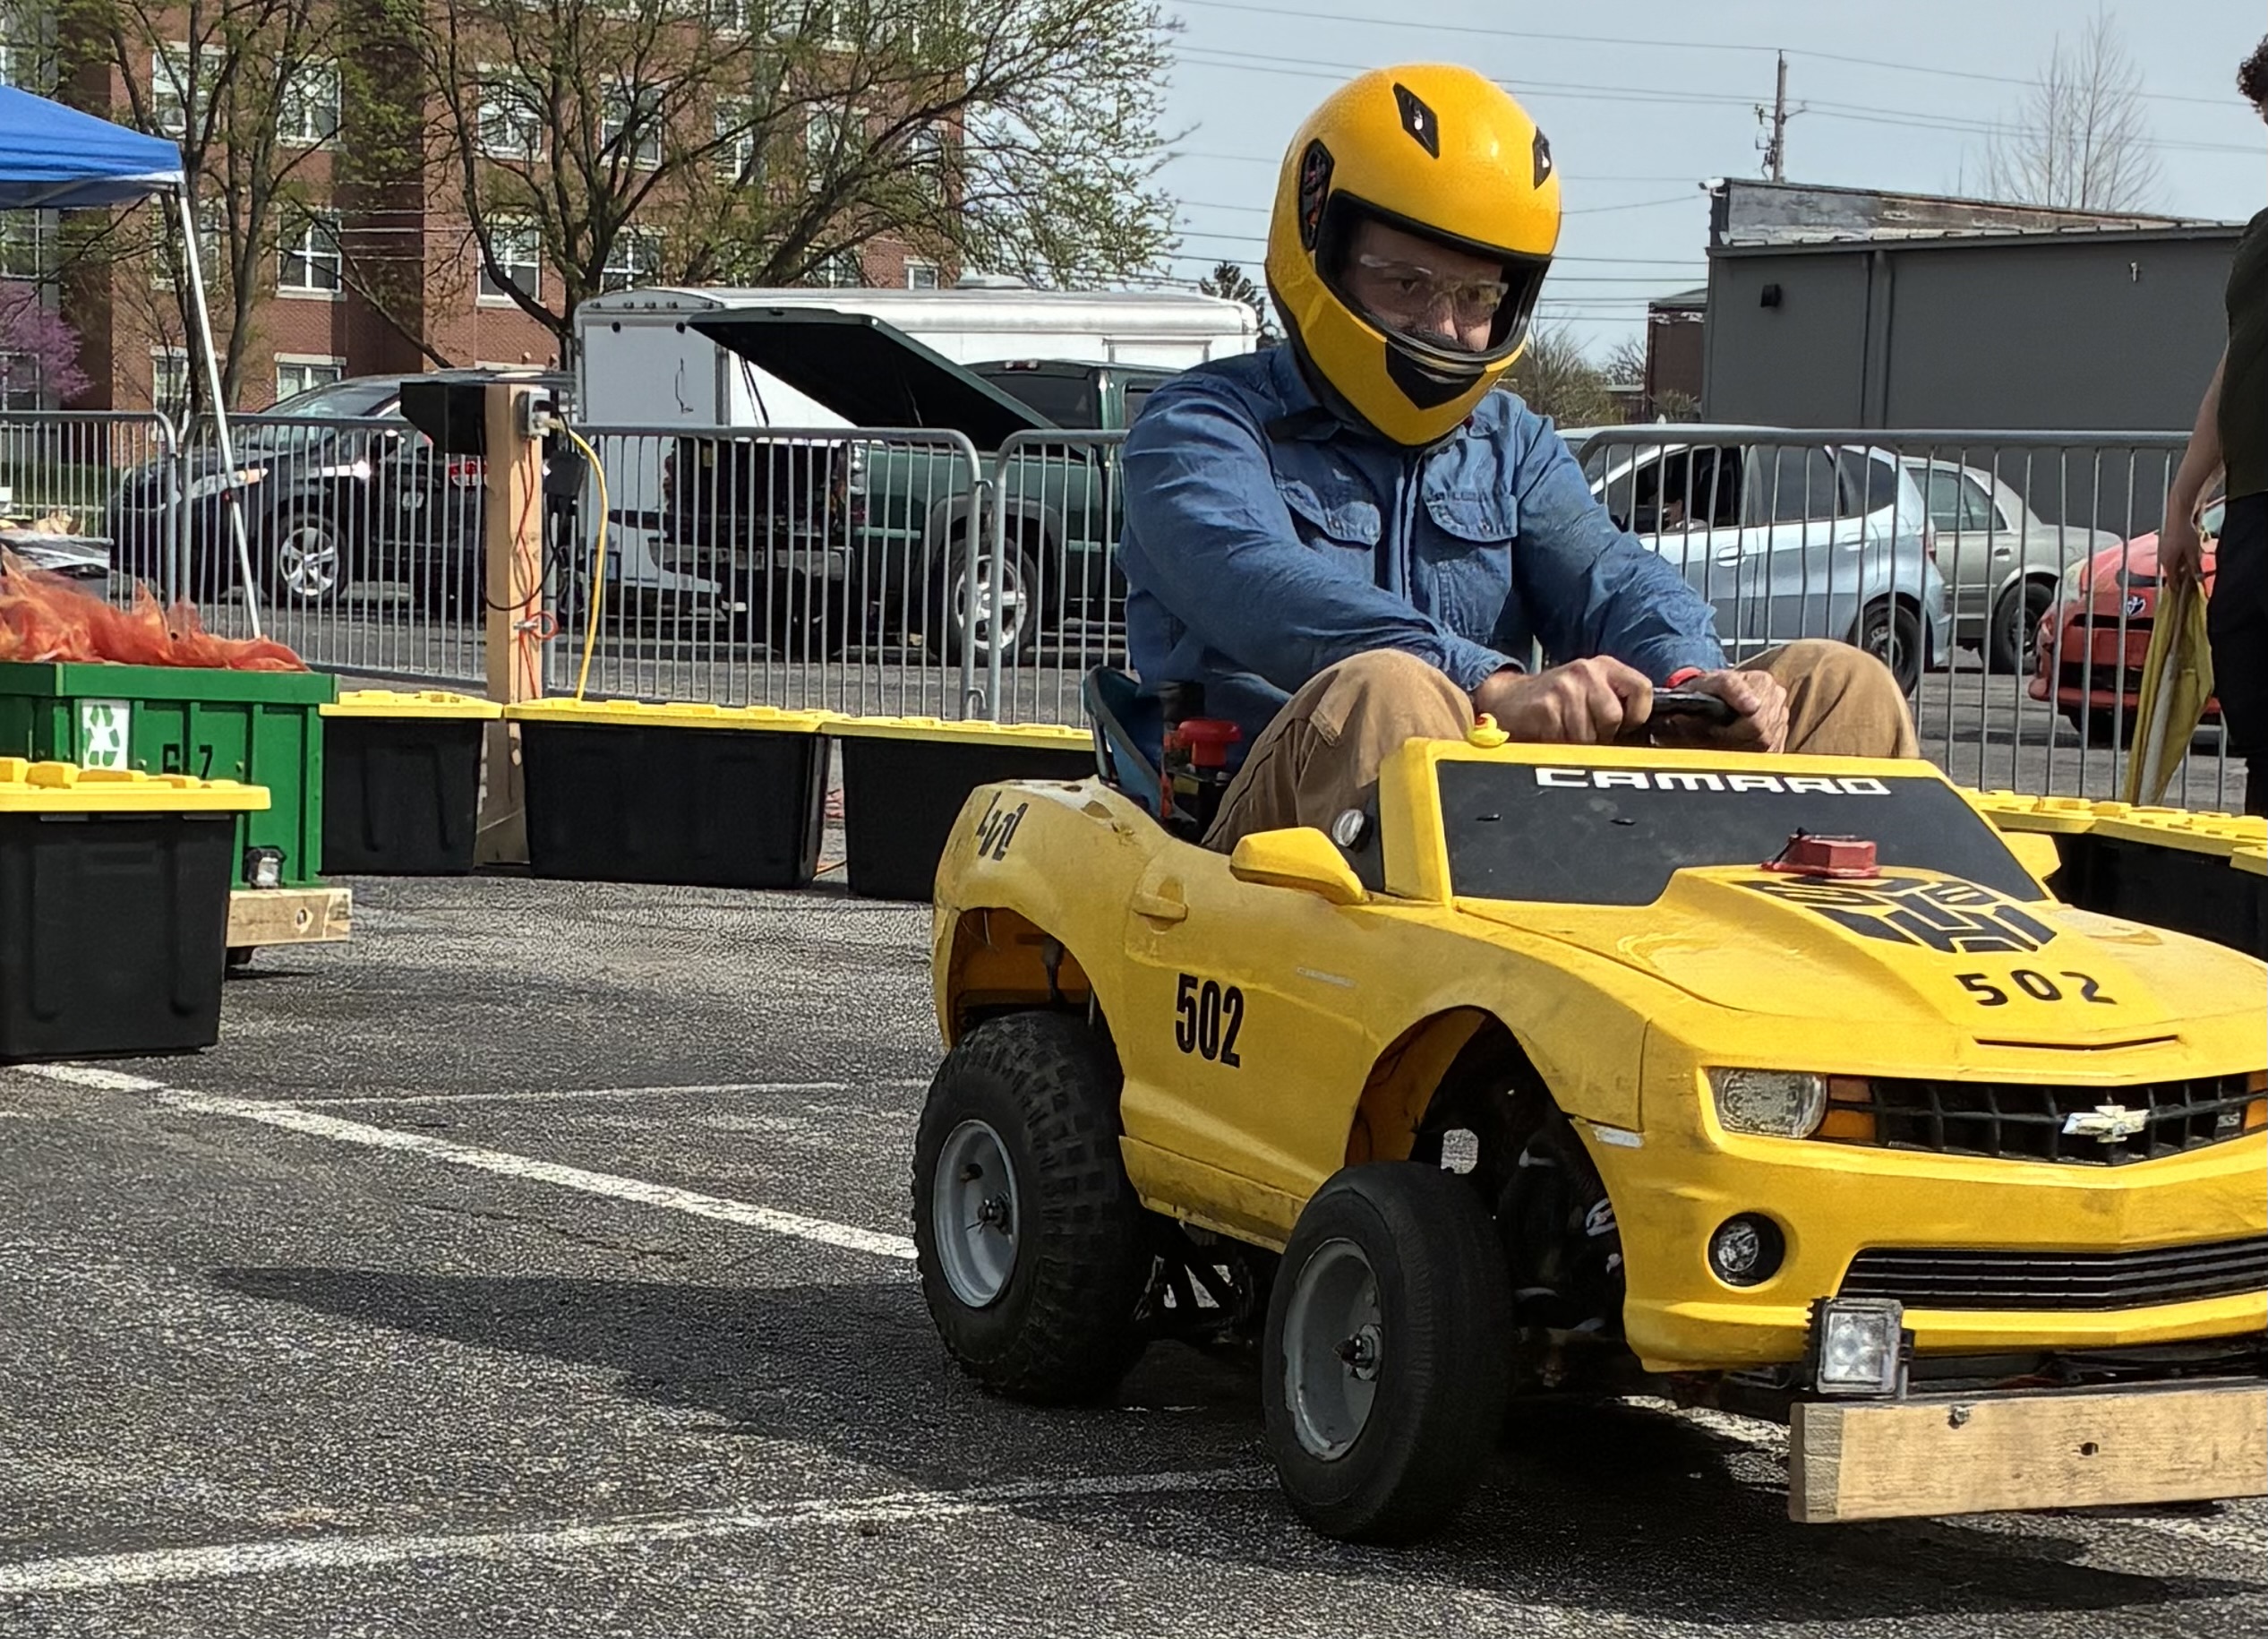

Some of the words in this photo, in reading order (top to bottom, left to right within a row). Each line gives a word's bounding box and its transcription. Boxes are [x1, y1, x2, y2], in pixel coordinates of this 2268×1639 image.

[1535, 768, 1891, 795] CAMARO
[1954, 969, 2118, 1007] 502
[1175, 972, 1244, 1069] 502
